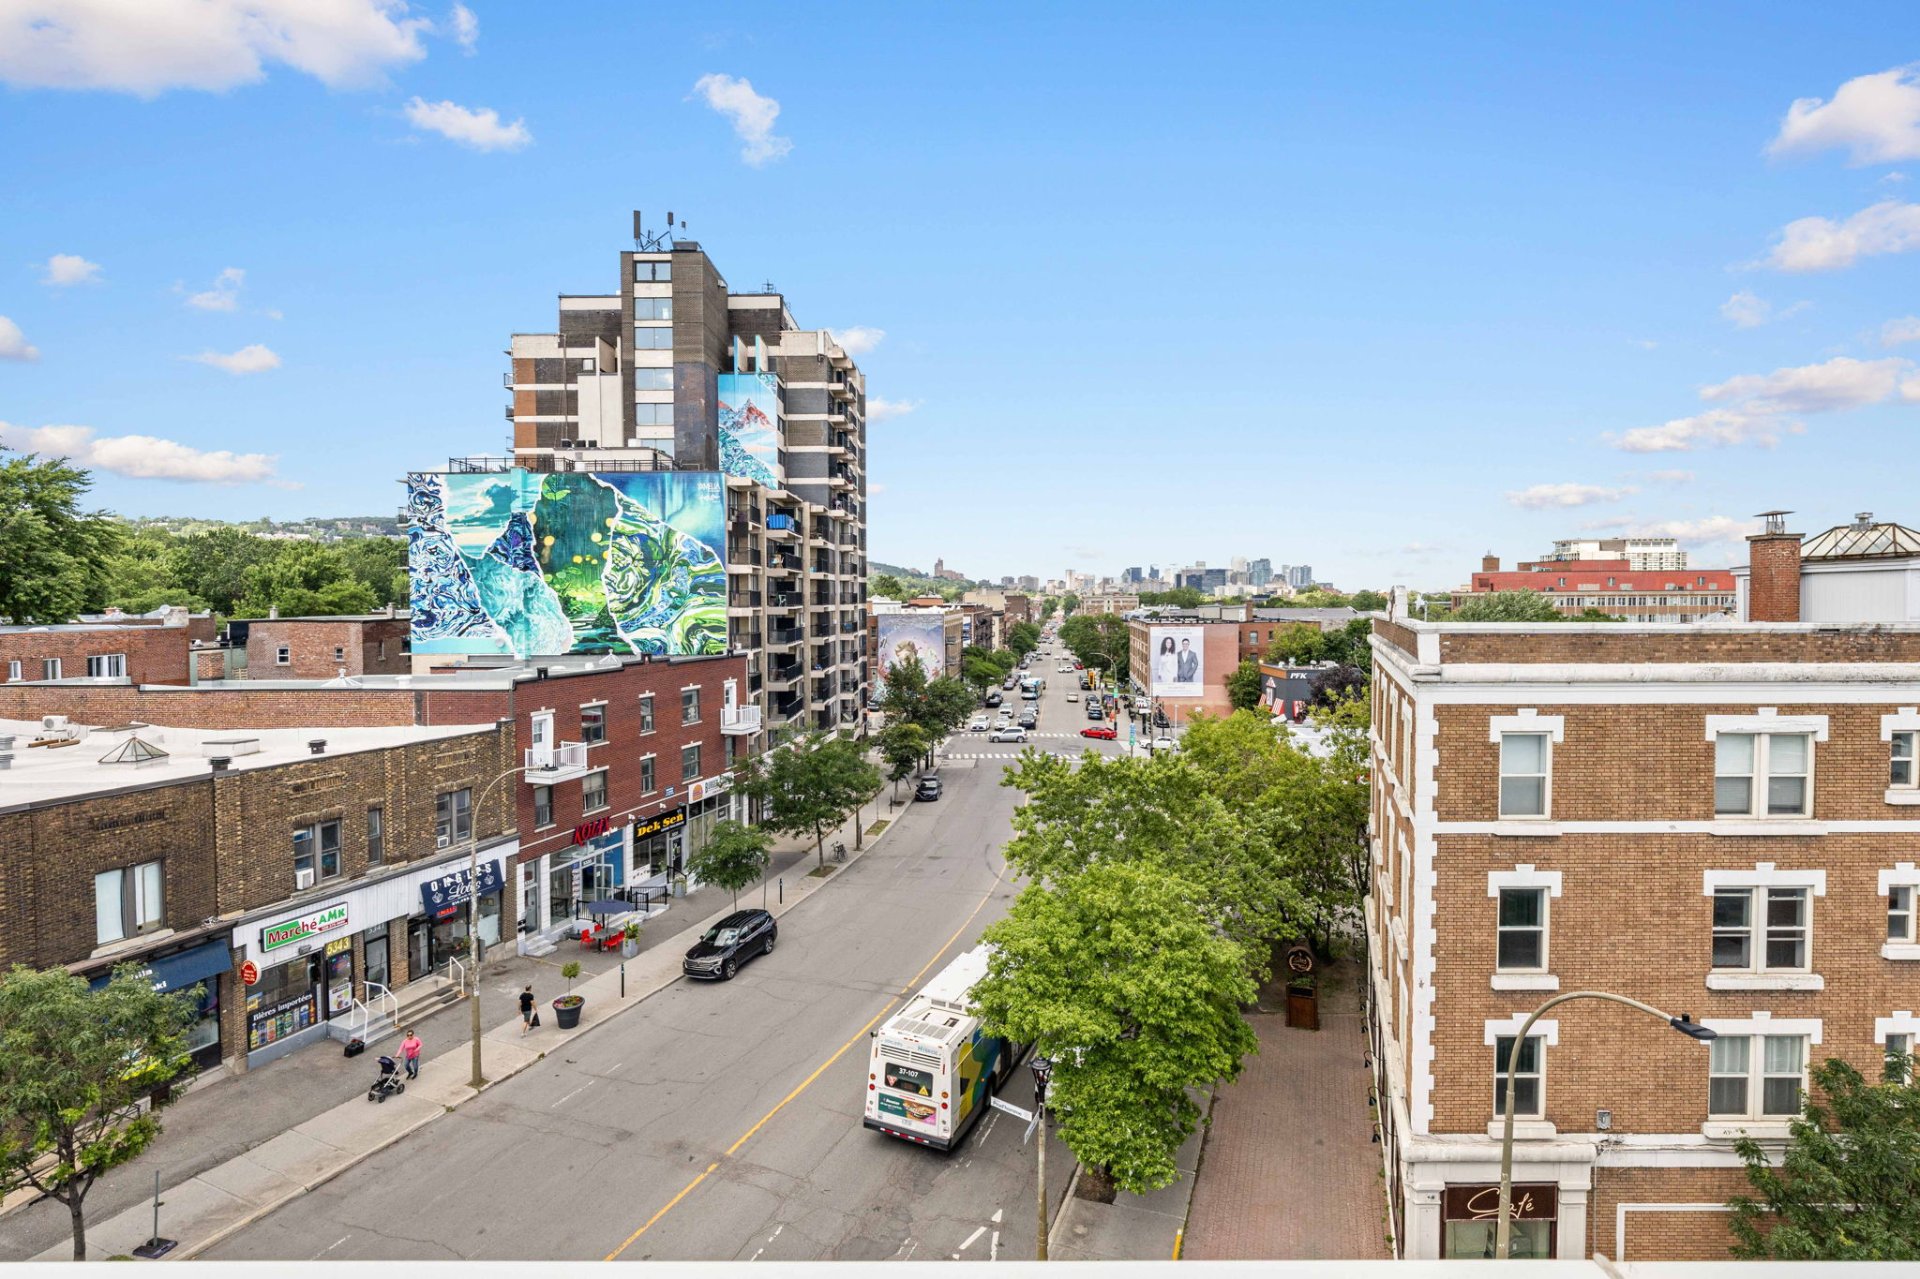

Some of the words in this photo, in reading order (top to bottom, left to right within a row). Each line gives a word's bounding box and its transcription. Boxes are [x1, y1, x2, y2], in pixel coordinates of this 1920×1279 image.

[637, 821, 660, 837] Dek
[663, 813, 684, 828] Sen
[268, 917, 317, 945] Marché
[318, 908, 345, 925] AMK
[326, 936, 349, 955] 5343
[253, 1007, 277, 1022] Bières
[277, 993, 313, 1012] importées
[899, 1067, 919, 1078] 37-107
[1467, 1187, 1535, 1221] Café
